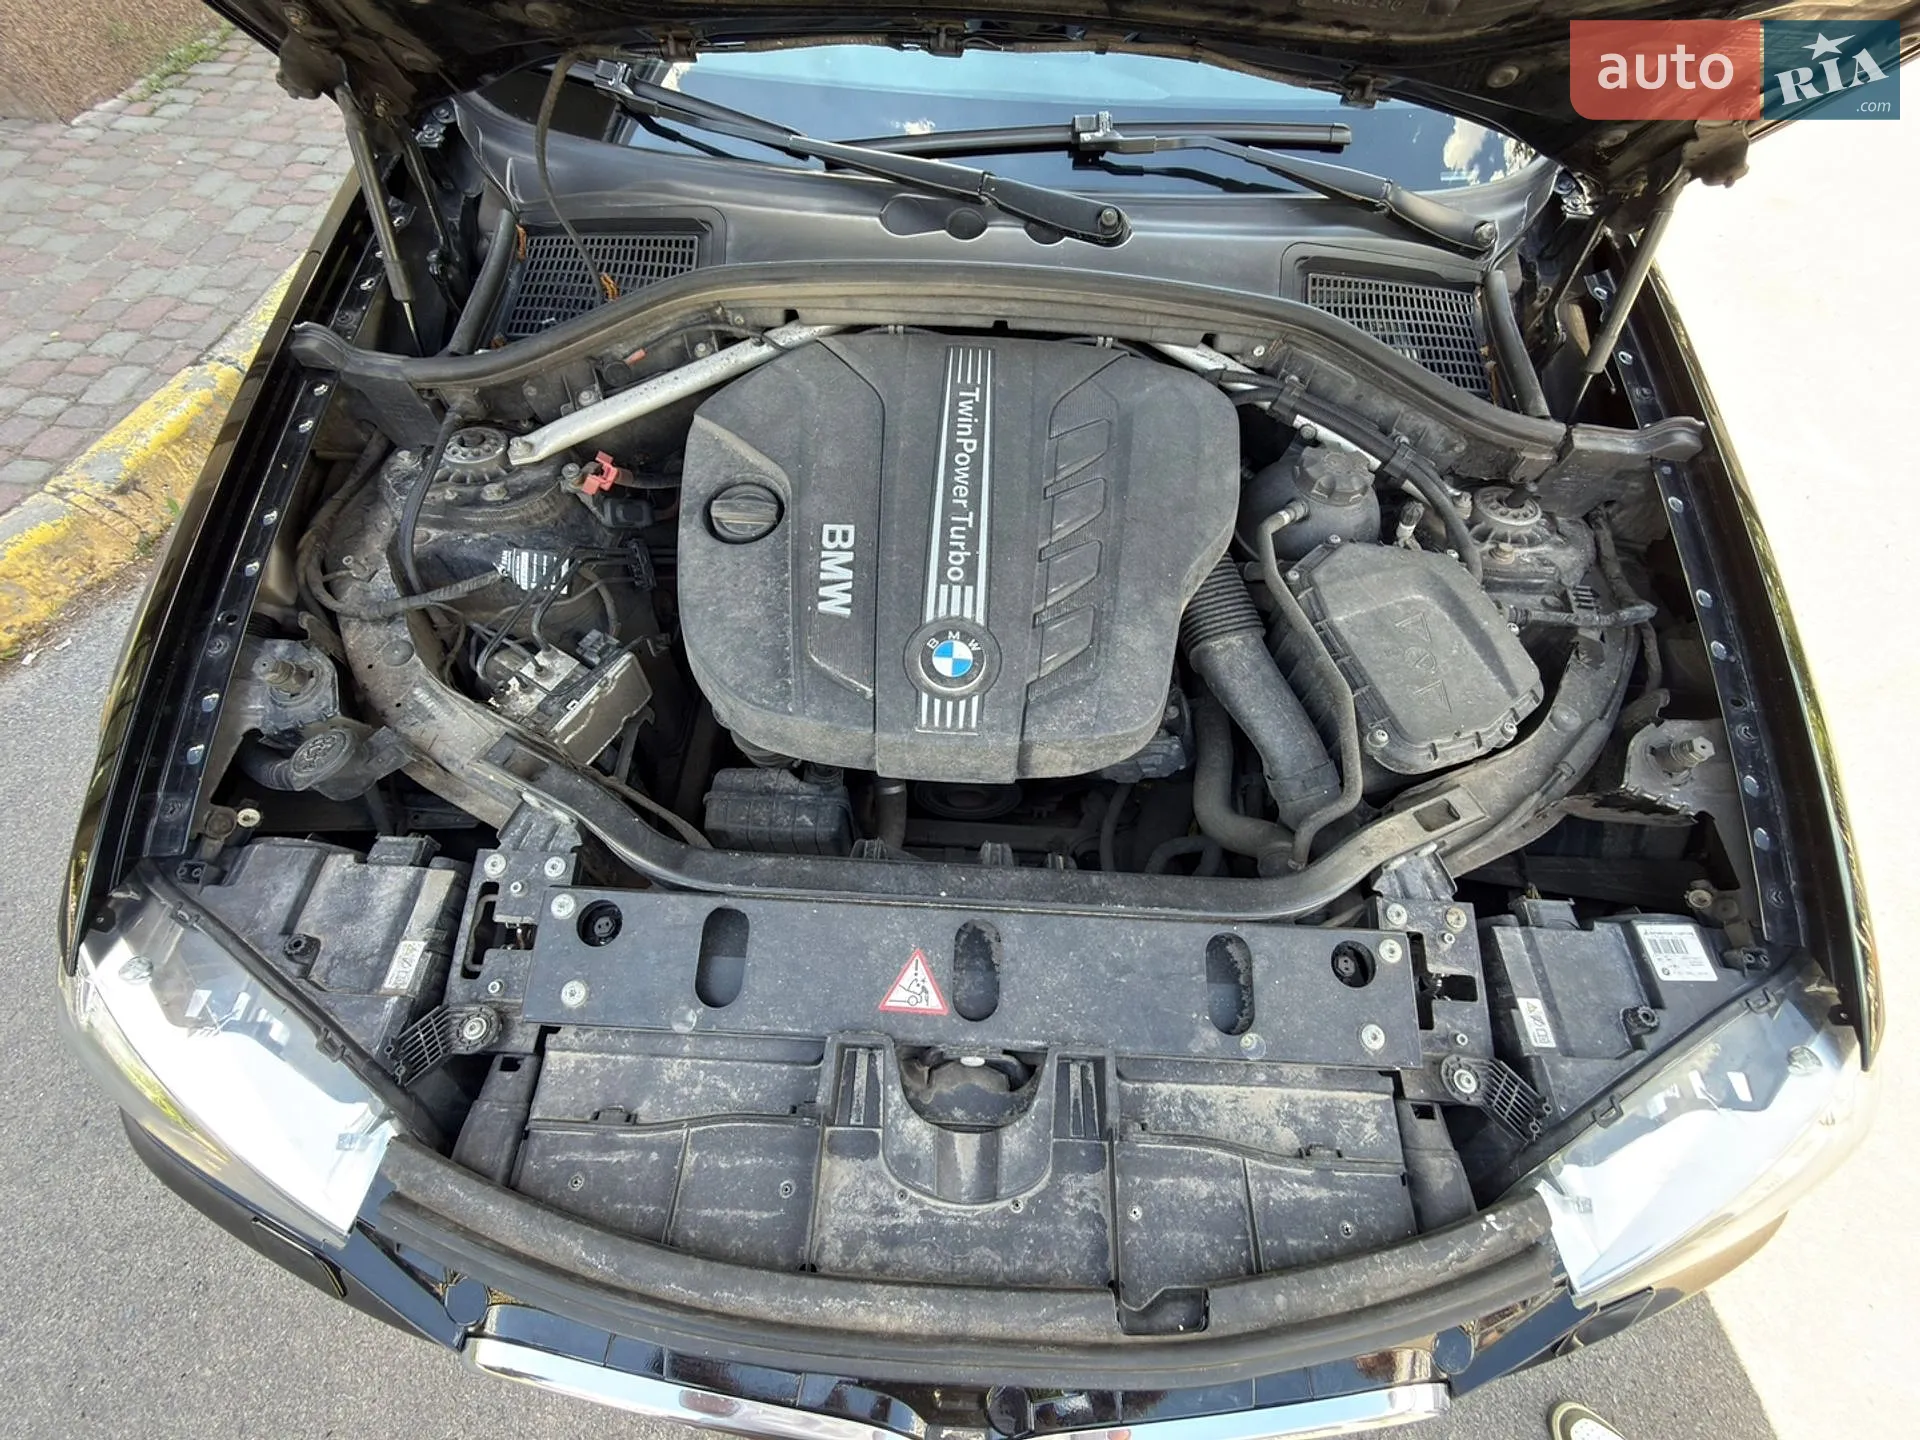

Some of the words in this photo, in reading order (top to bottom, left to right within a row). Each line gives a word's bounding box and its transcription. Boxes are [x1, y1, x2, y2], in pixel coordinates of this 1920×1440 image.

[951, 387, 980, 508] TwinPower
[818, 524, 855, 618] BMW
[947, 511, 974, 581] Turbo
[926, 630, 981, 651] BMW
